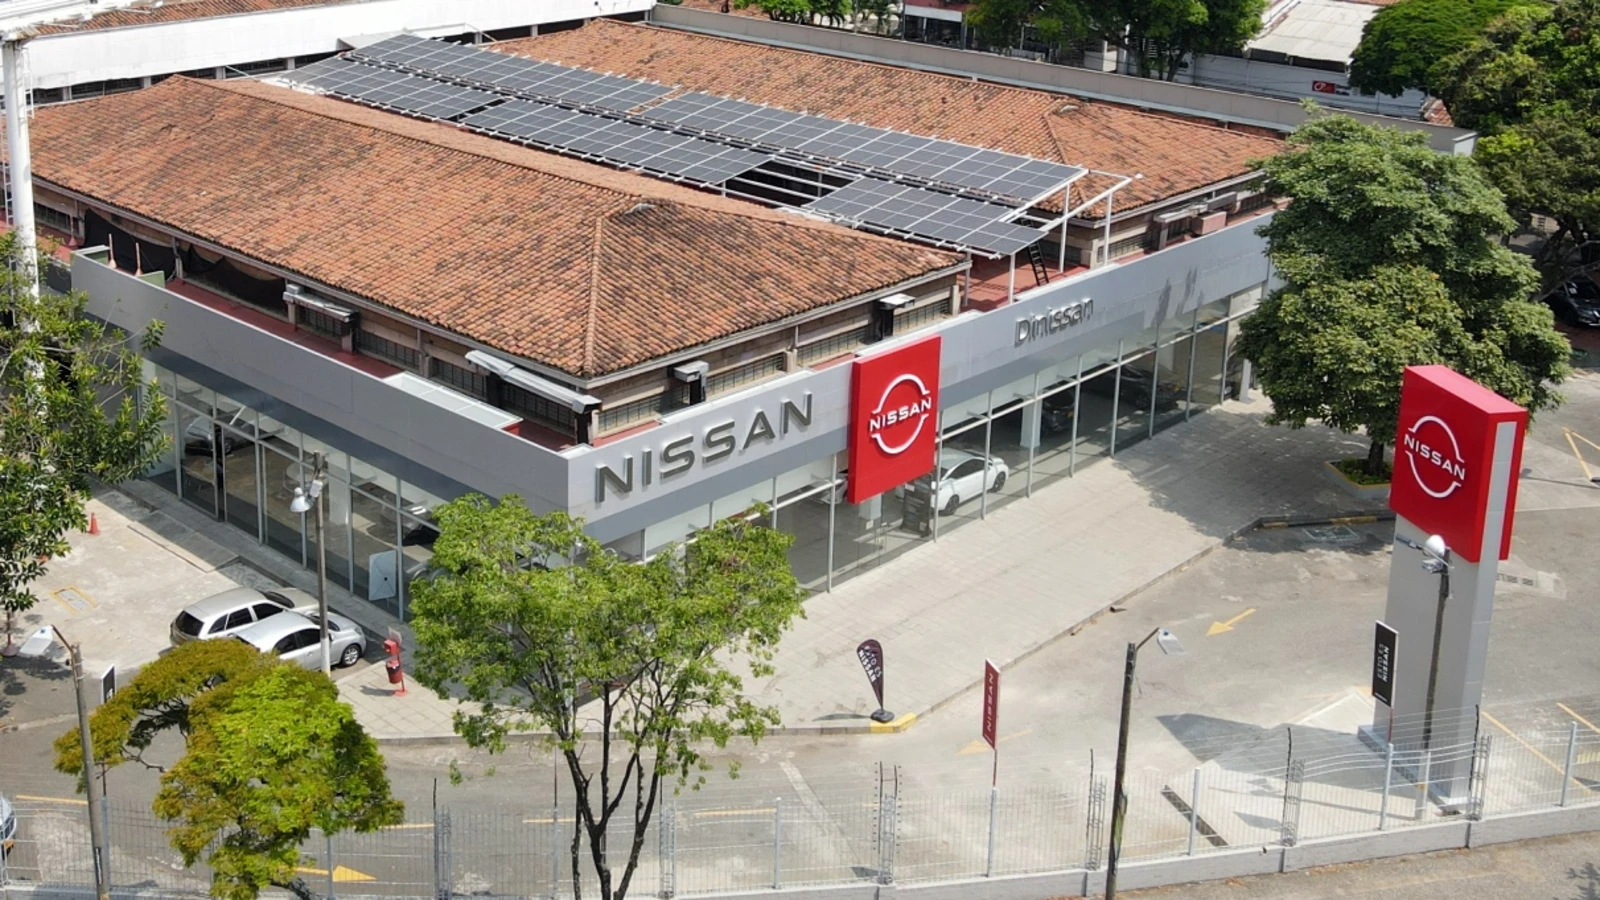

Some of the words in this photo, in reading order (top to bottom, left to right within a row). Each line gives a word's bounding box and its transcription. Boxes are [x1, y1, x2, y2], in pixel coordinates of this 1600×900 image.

[1014, 298, 1094, 346] Dinissan
[869, 396, 932, 432] NISSAN
[595, 391, 813, 504] NISSAN
[1404, 433, 1466, 480] NISSAN
[858, 649, 877, 682] NISSAN
[1382, 645, 1390, 683] NISSAN
[986, 672, 995, 733] NISSAN
